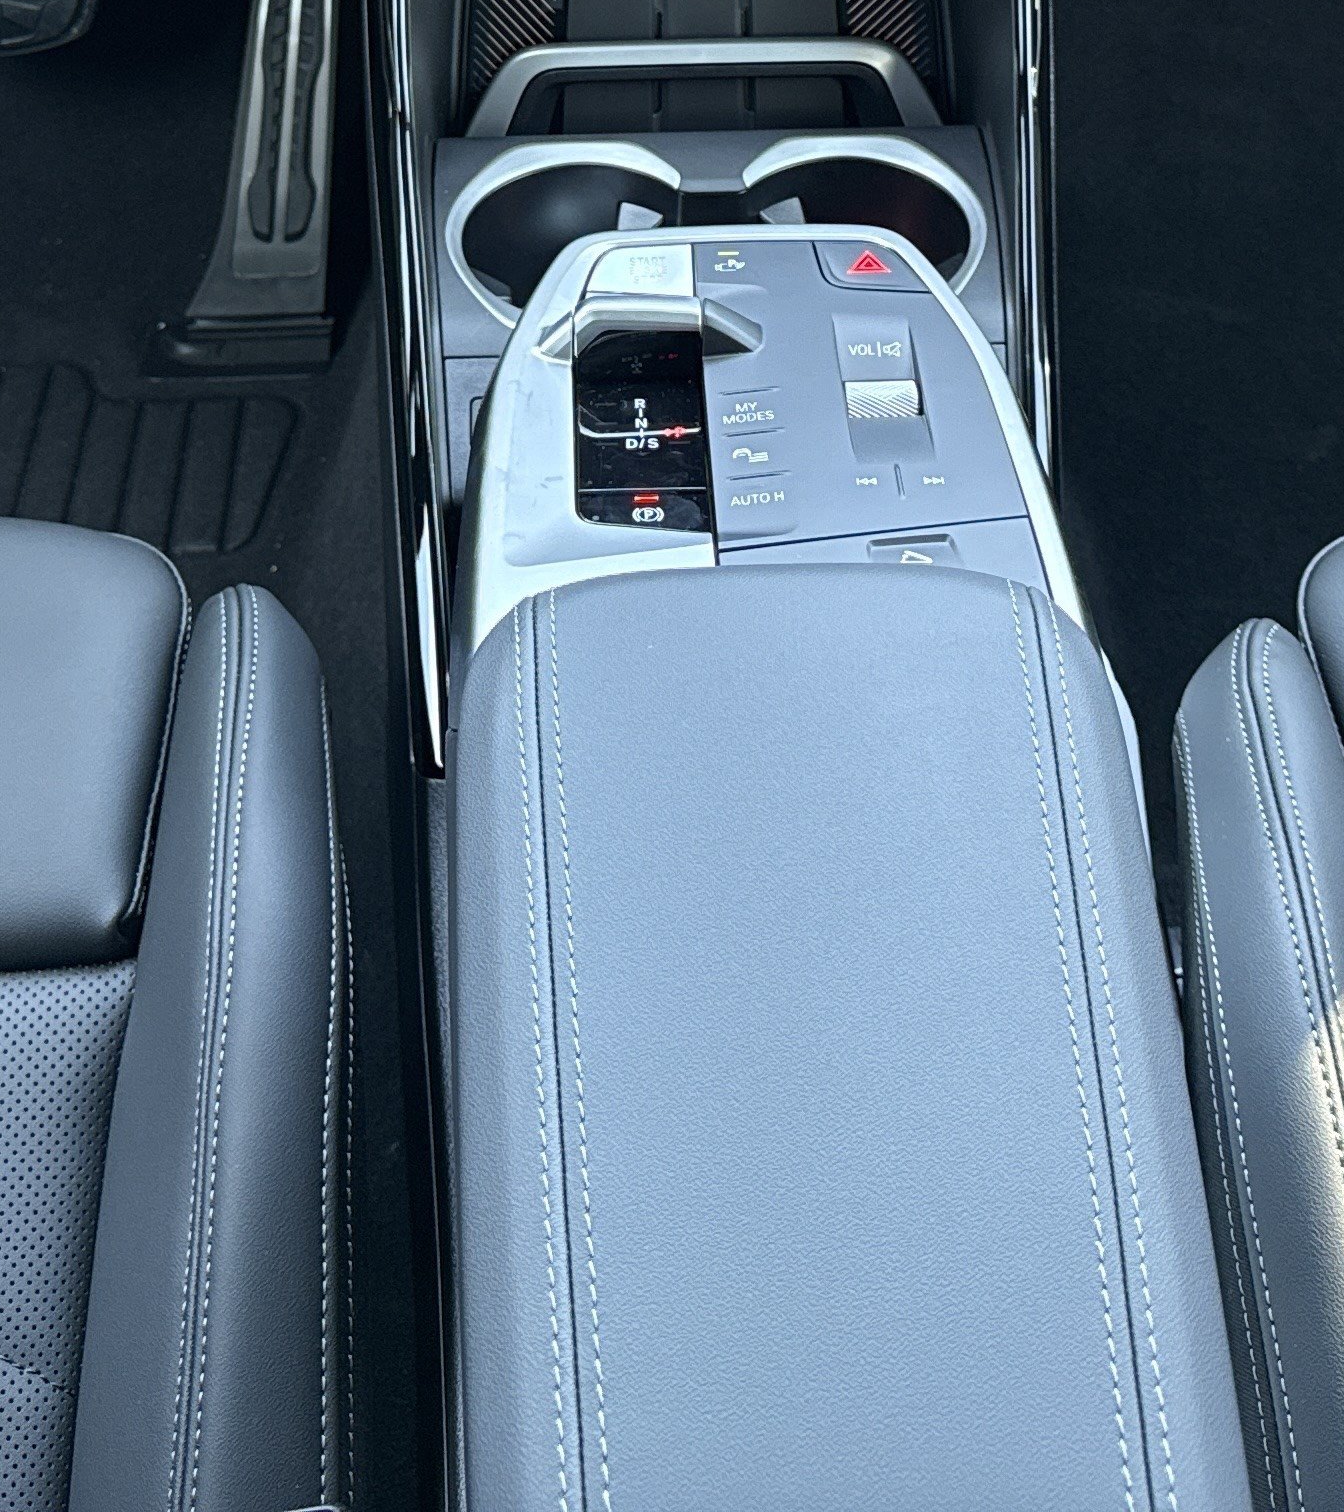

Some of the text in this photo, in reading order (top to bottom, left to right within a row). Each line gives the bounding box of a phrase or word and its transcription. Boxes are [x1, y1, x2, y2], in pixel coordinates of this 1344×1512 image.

[847, 343, 875, 356] VOL
[634, 398, 646, 409] R
[735, 401, 758, 413] MY
[634, 418, 648, 429] N
[722, 410, 775, 425] MODES
[730, 491, 785, 507] AUTO H
